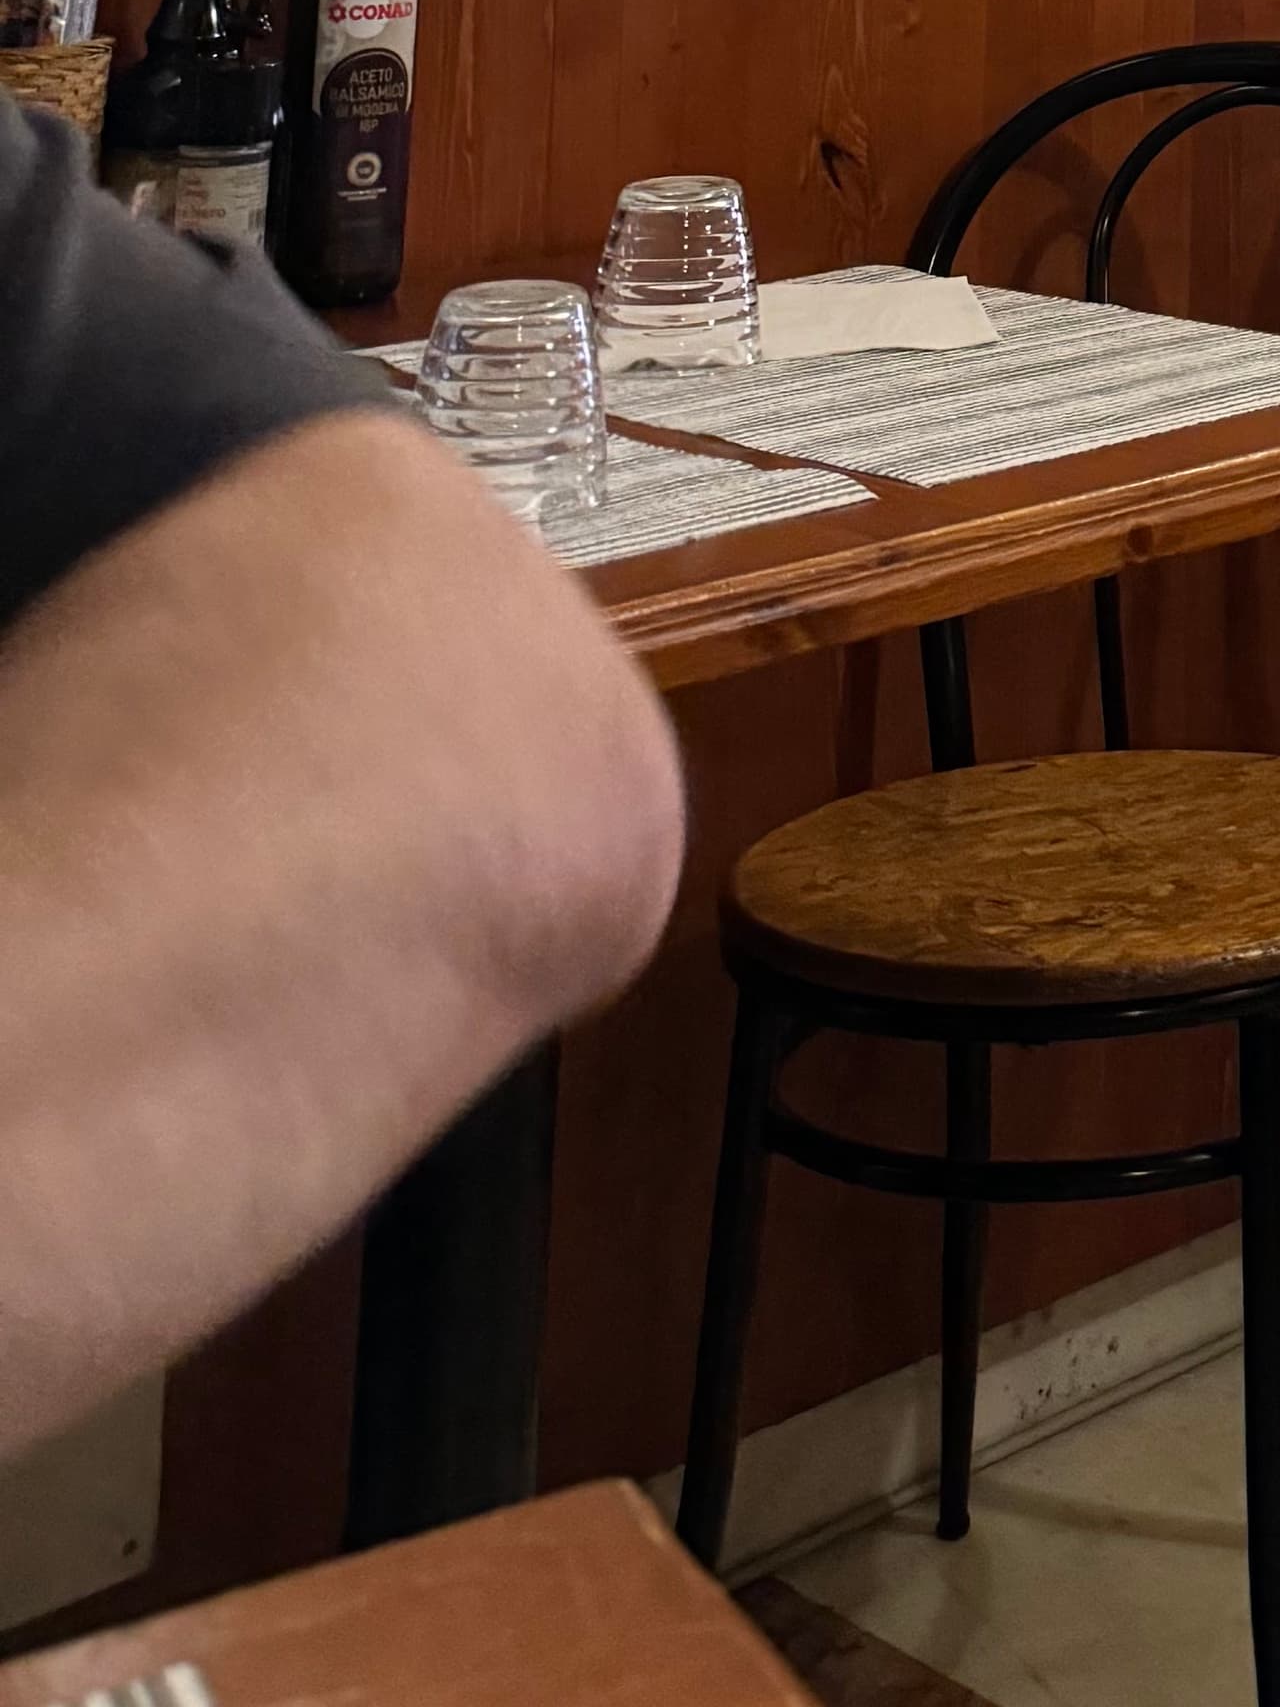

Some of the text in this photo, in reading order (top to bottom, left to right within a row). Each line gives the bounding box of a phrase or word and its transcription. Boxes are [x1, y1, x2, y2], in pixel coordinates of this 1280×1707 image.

[349, 1, 414, 21] CONAD
[350, 67, 393, 85] ACETO
[328, 81, 405, 103] BALSAMICO
